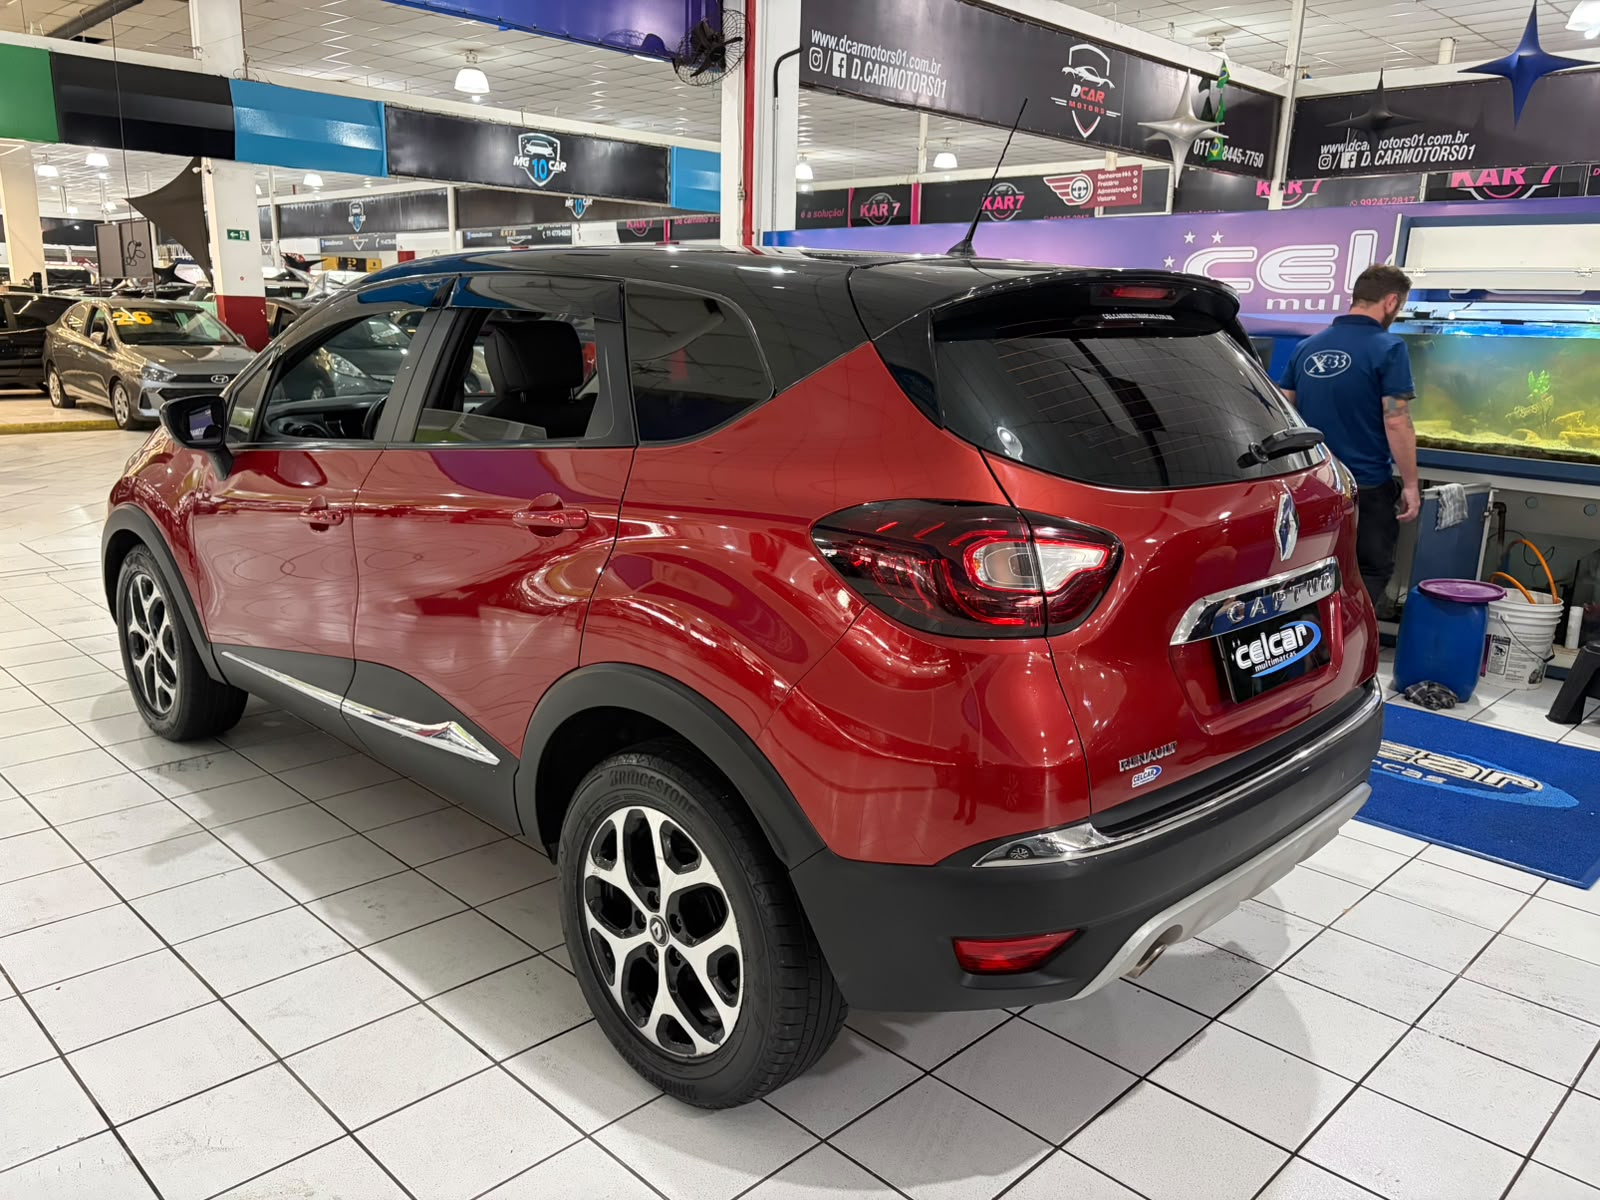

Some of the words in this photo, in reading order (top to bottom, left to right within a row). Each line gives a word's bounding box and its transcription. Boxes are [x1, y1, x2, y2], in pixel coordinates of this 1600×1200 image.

[811, 29, 941, 76] www.dcarmotors01.com.br
[851, 58, 947, 98] D.CARMOTORS01
[1069, 101, 1105, 115] MOTORS
[1071, 84, 1105, 104] DCAR
[513, 156, 530, 167] MG
[532, 159, 548, 180] 10
[548, 161, 567, 172] CAR
[1193, 139, 1210, 157] 011
[1222, 146, 1264, 168] 8445-7750
[860, 203, 889, 217] KAR
[892, 202, 901, 216] 7
[112, 311, 153, 326] 26
[1227, 573, 1332, 623] CAPTUR
[1235, 624, 1308, 670] celcar
[1254, 651, 1297, 672] multimarcas
[1119, 741, 1177, 772] RENAULT
[610, 769, 697, 818] BRIDGESTONE
